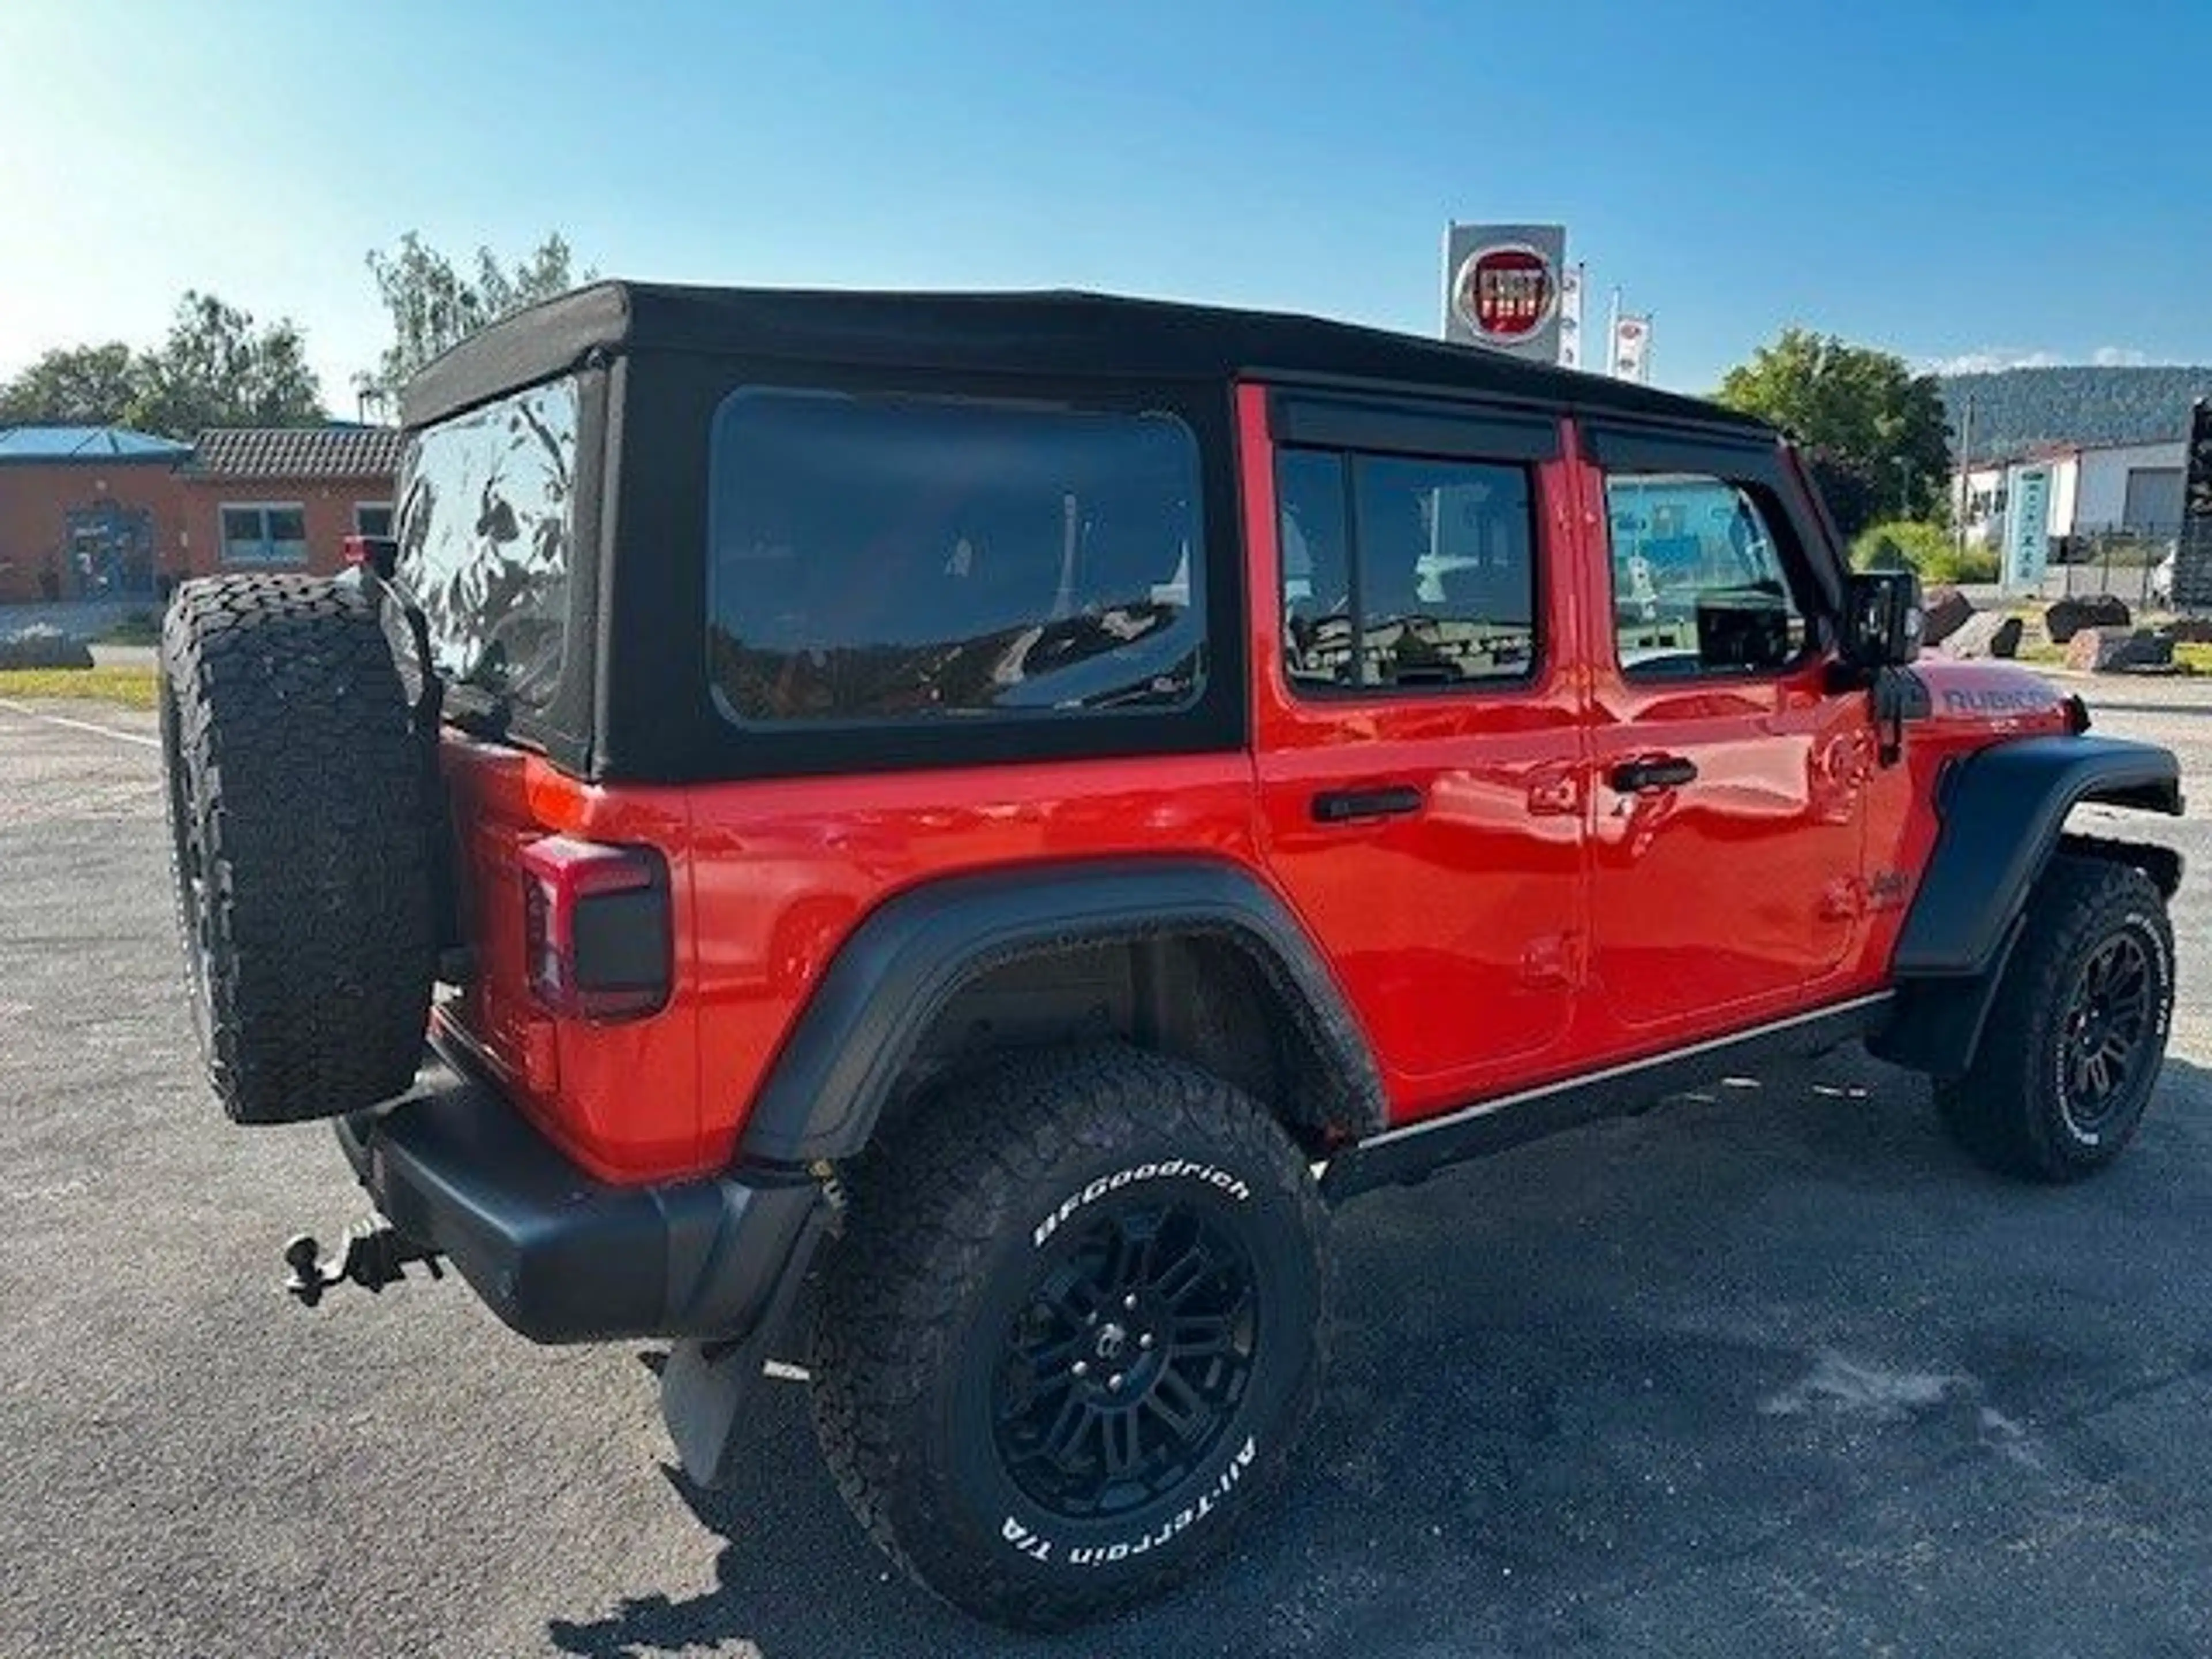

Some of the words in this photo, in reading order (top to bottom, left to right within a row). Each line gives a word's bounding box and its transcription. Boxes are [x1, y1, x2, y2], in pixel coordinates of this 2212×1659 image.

[1034, 1158, 1250, 1247] BFGoodrich
[1002, 1516, 1052, 1561] T/A
[1069, 1434, 1256, 1566] All-Terrain
